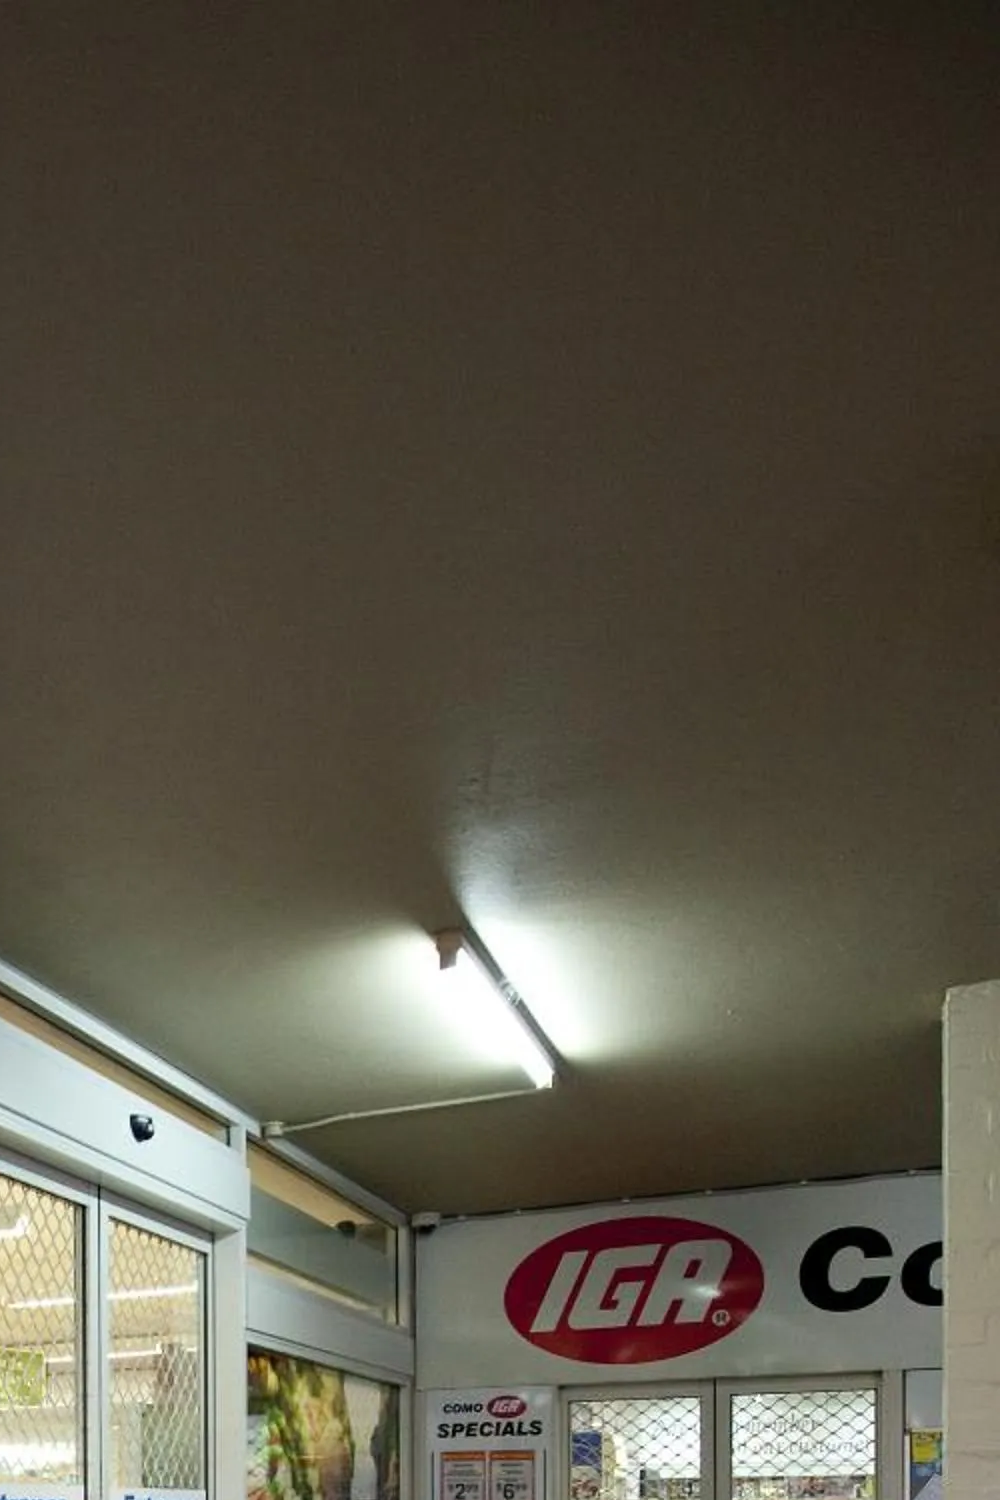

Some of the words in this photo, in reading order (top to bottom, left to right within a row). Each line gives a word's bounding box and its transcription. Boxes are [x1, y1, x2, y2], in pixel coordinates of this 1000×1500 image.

[528, 1238, 734, 1334] IGA
[442, 1403, 484, 1414] COMO
[491, 1399, 521, 1413] IGA
[436, 1419, 544, 1438] SPECIALS
